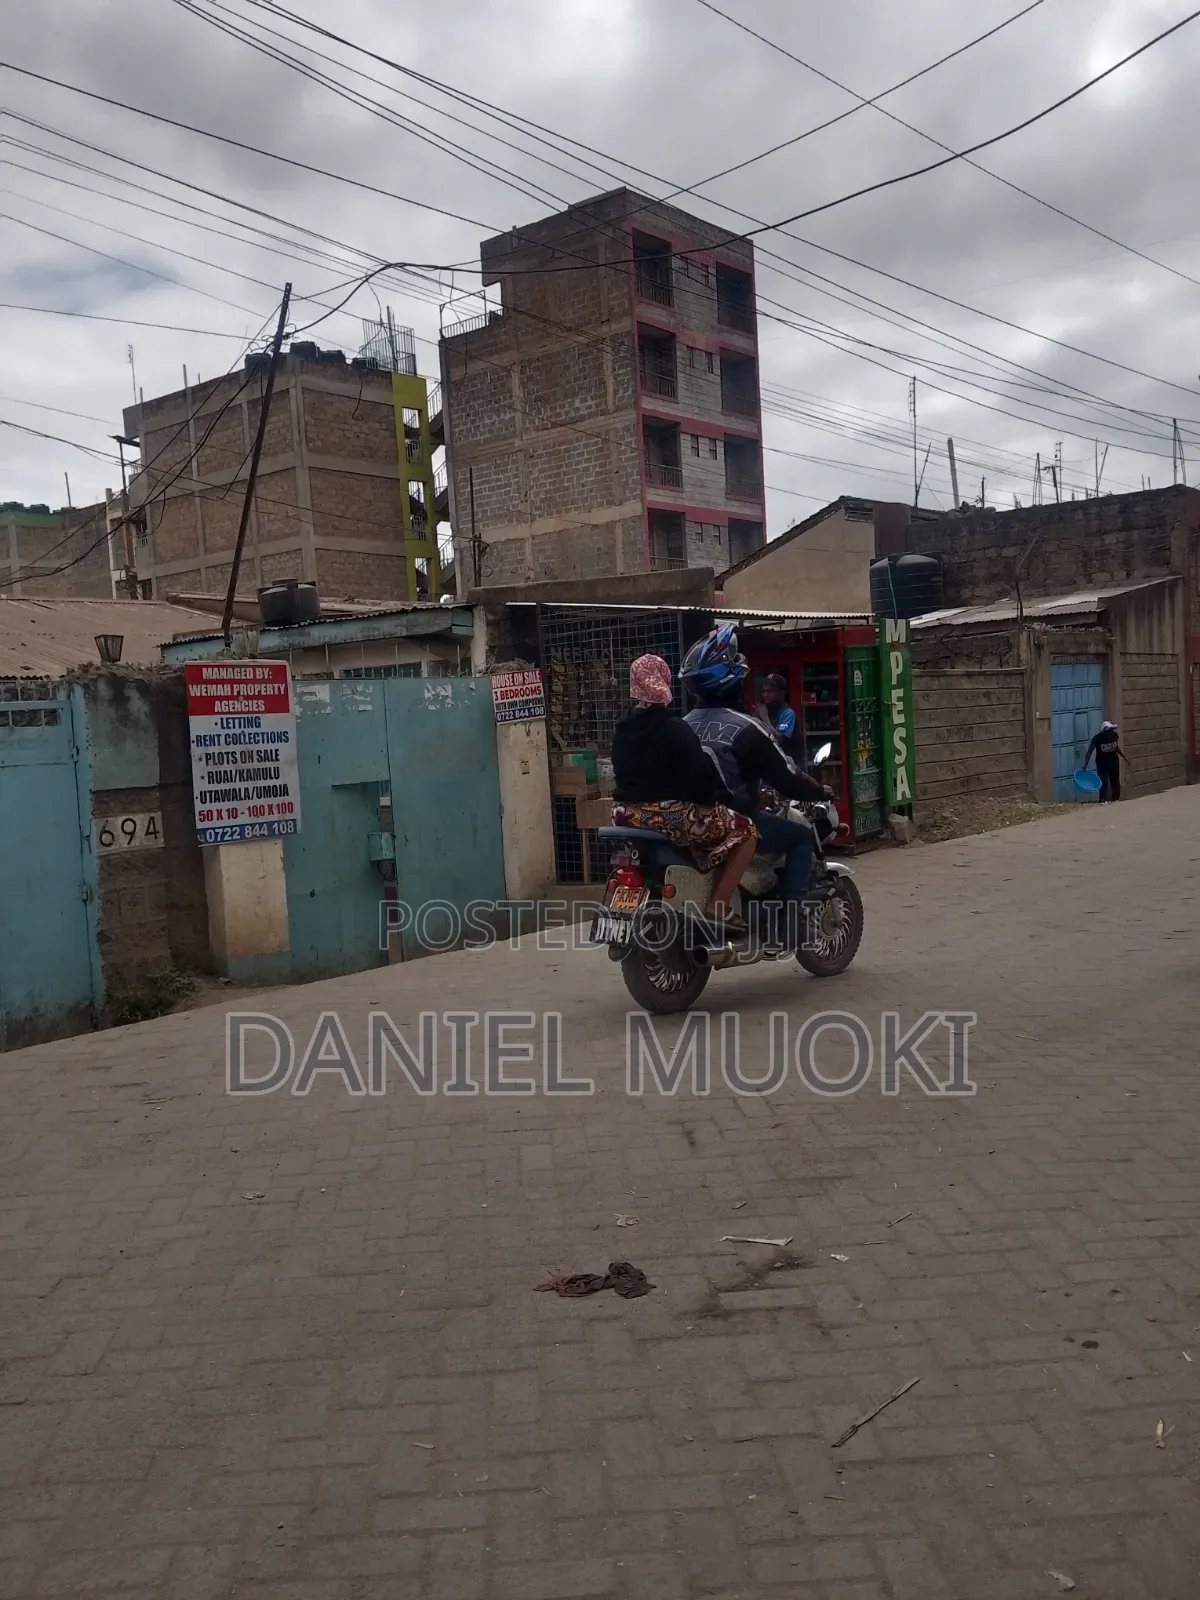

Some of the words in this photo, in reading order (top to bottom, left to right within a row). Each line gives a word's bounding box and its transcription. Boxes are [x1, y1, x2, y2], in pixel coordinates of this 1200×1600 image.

[202, 667, 254, 680] MANAGED
[255, 667, 273, 680] BY:
[491, 673, 513, 688] HOUSE
[513, 672, 524, 686] ON
[523, 670, 541, 684] SALE
[188, 684, 232, 697] WEMAH
[232, 683, 286, 696] PROPERTY
[493, 691, 499, 701] 3
[500, 686, 542, 700] BEDROOMS
[214, 699, 265, 713] AGENCIES
[496, 712, 514, 721] 0722
[515, 709, 529, 718] 844
[531, 706, 545, 716] 108
[220, 716, 262, 730] LETTING
[195, 734, 222, 748] RENT
[224, 731, 290, 746] COLLECTIONS
[205, 751, 238, 767] PLOTS
[239, 750, 254, 764] ON
[256, 748, 280, 763] SALE
[207, 766, 280, 785] RUAI/KAMULU
[199, 784, 290, 805] UTAWALA/UMOJA
[198, 809, 214, 823] 50
[216, 808, 224, 821] X
[225, 807, 238, 820] 10
[246, 804, 265, 818] 100
[267, 803, 275, 816] X
[276, 801, 294, 815] 100
[99, 816, 160, 848] 694
[206, 826, 241, 843] 0722
[244, 823, 269, 838] 844
[272, 820, 294, 835] 108
